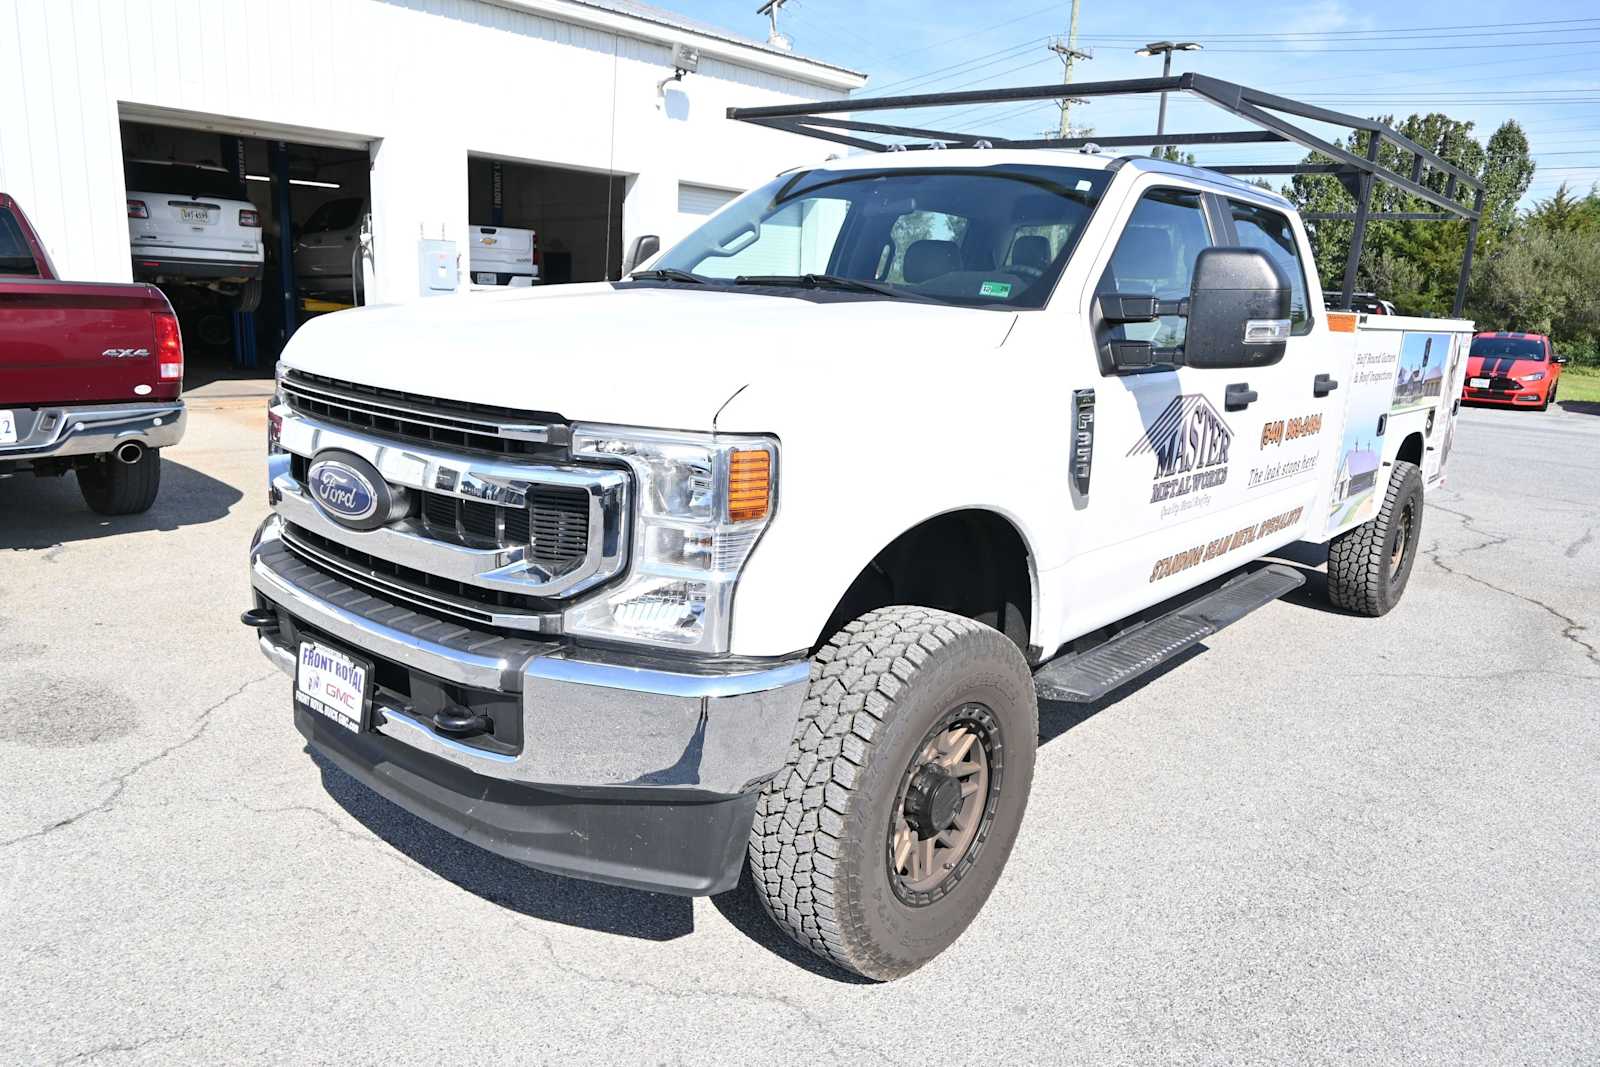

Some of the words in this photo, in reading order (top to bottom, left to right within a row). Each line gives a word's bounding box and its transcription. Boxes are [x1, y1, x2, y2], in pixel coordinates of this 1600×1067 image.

[1153, 403, 1231, 480] MASTER
[319, 470, 357, 509] Ford
[1248, 467, 1263, 486] The
[1264, 462, 1281, 481] leak
[1281, 459, 1301, 477] stops
[1149, 544, 1205, 583] STANDING
[1202, 533, 1234, 562] SEAM
[1229, 523, 1259, 551] METAL
[302, 647, 334, 674] FRONT
[335, 661, 363, 694] ROYAL
[326, 682, 356, 710] GMC
